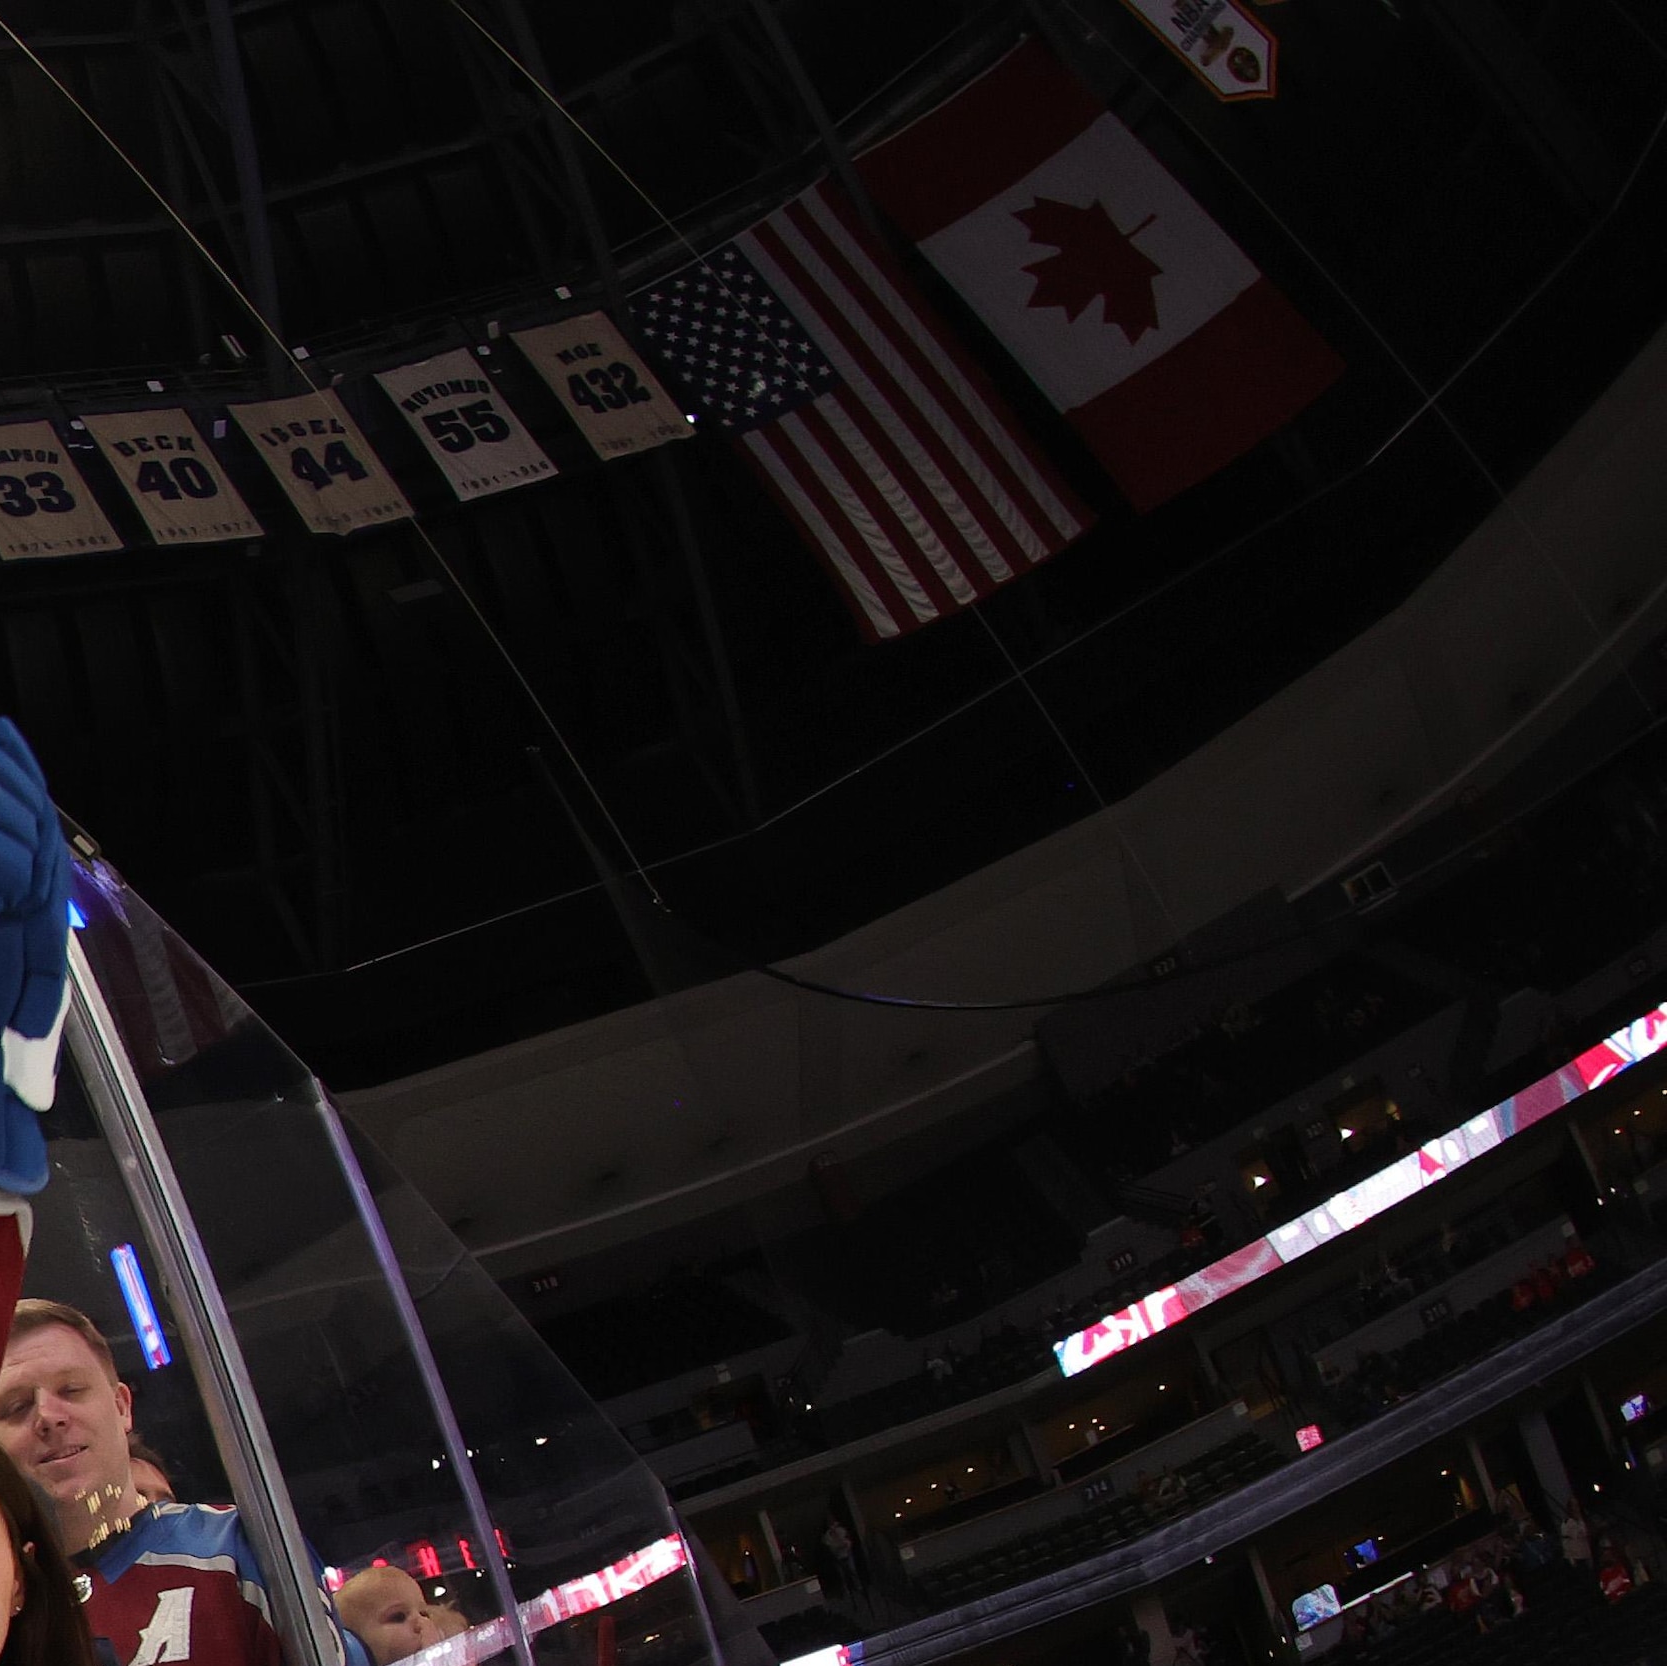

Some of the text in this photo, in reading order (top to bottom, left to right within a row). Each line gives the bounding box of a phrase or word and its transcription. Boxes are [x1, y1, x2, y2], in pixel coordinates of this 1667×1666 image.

[557, 343, 602, 365] MOE
[400, 378, 490, 413] MUTOMBO
[567, 361, 651, 413] 432
[260, 418, 347, 446] ISSEL
[422, 399, 510, 453] 55
[112, 435, 195, 457] BECK
[291, 440, 368, 490] 44
[137, 456, 218, 500] 40
